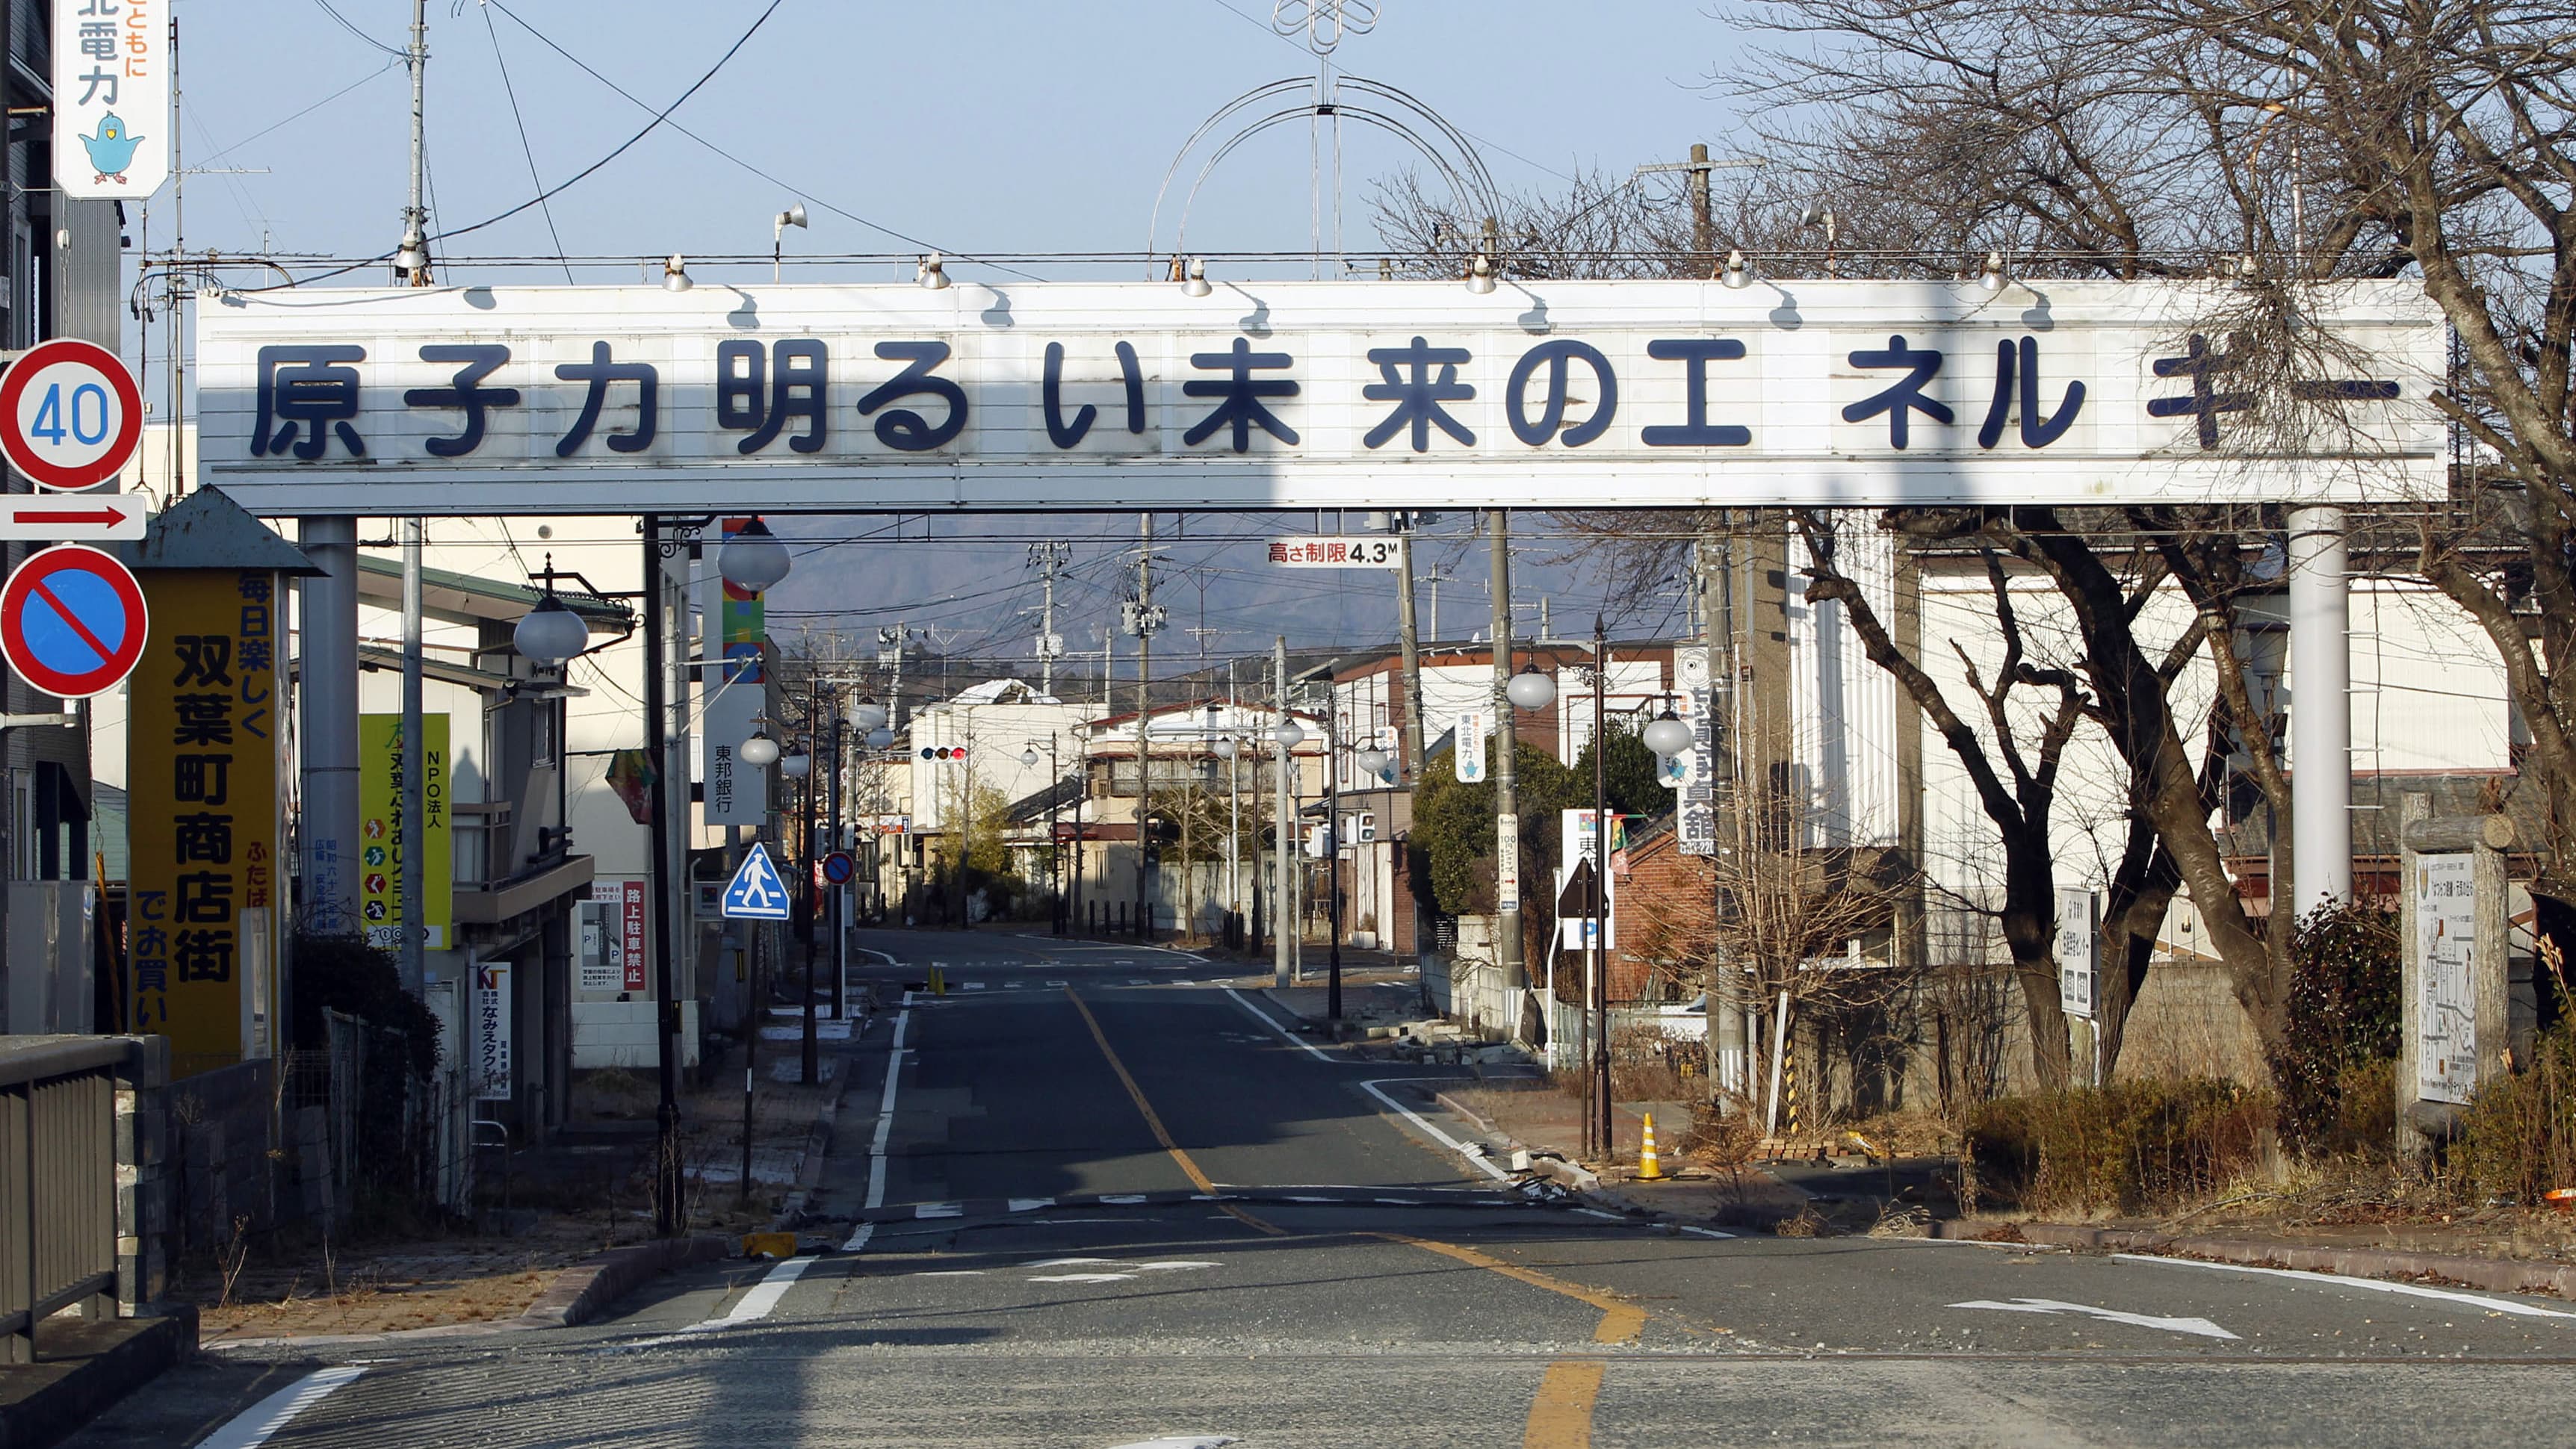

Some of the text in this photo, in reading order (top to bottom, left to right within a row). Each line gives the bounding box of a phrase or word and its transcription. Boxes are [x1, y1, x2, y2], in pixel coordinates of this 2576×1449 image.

[126, 0, 147, 78] ともに
[31, 383, 108, 445] 40
[238, 571, 270, 739] 毎日楽しく
[1461, 715, 1472, 759] 東北電力
[173, 635, 233, 983] 双葉町商店街
[427, 751, 442, 828] NPO法人
[715, 745, 732, 813] 東邦銀行
[135, 890, 168, 1034] でお買い
[584, 935, 591, 943] P
[611, 950, 619, 960] P
[626, 889, 641, 983] 路上駐車禁止
[483, 1006, 498, 1090] なみえタクシー
